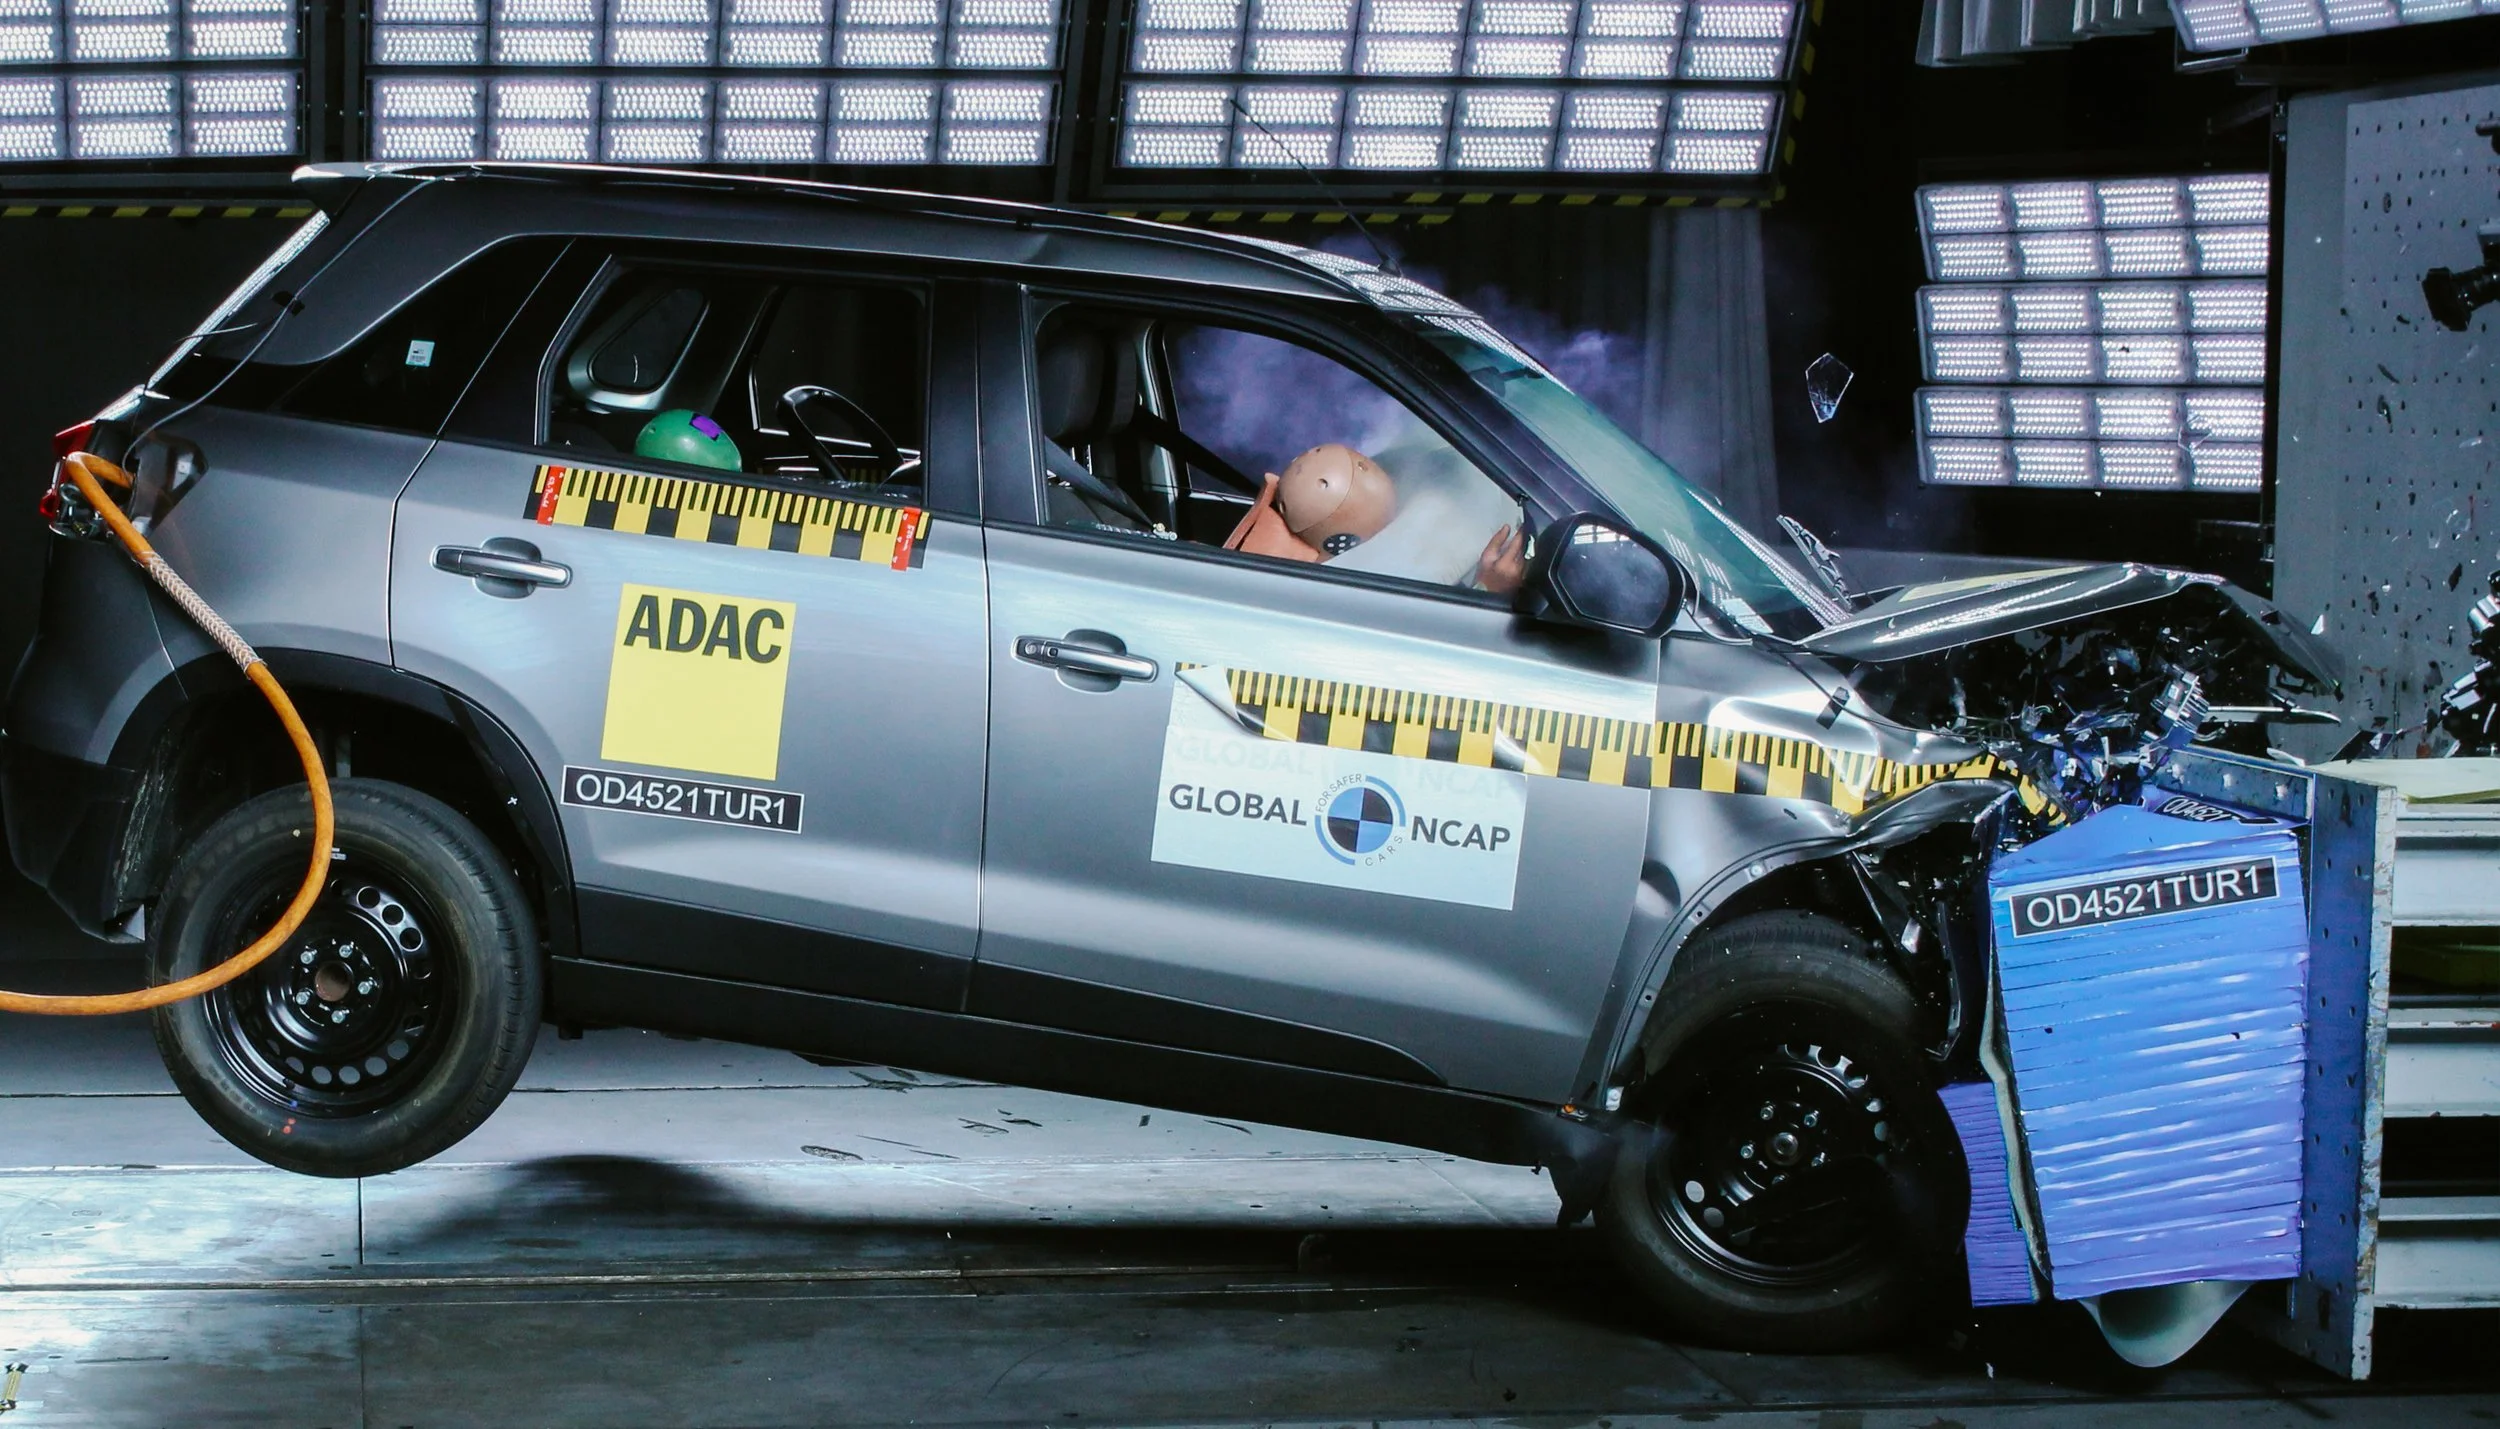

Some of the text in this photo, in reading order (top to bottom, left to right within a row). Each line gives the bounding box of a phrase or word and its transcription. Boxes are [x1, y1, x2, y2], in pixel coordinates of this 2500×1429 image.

[623, 594, 785, 664] ADAC
[575, 773, 786, 826] OD4521TUR1
[1169, 784, 1511, 852] GLOBAL NCAP
[1315, 773, 1362, 813] FOR SAFER
[1364, 835, 1403, 867] CARS
[2026, 865, 2260, 928] OD4521TUR1
